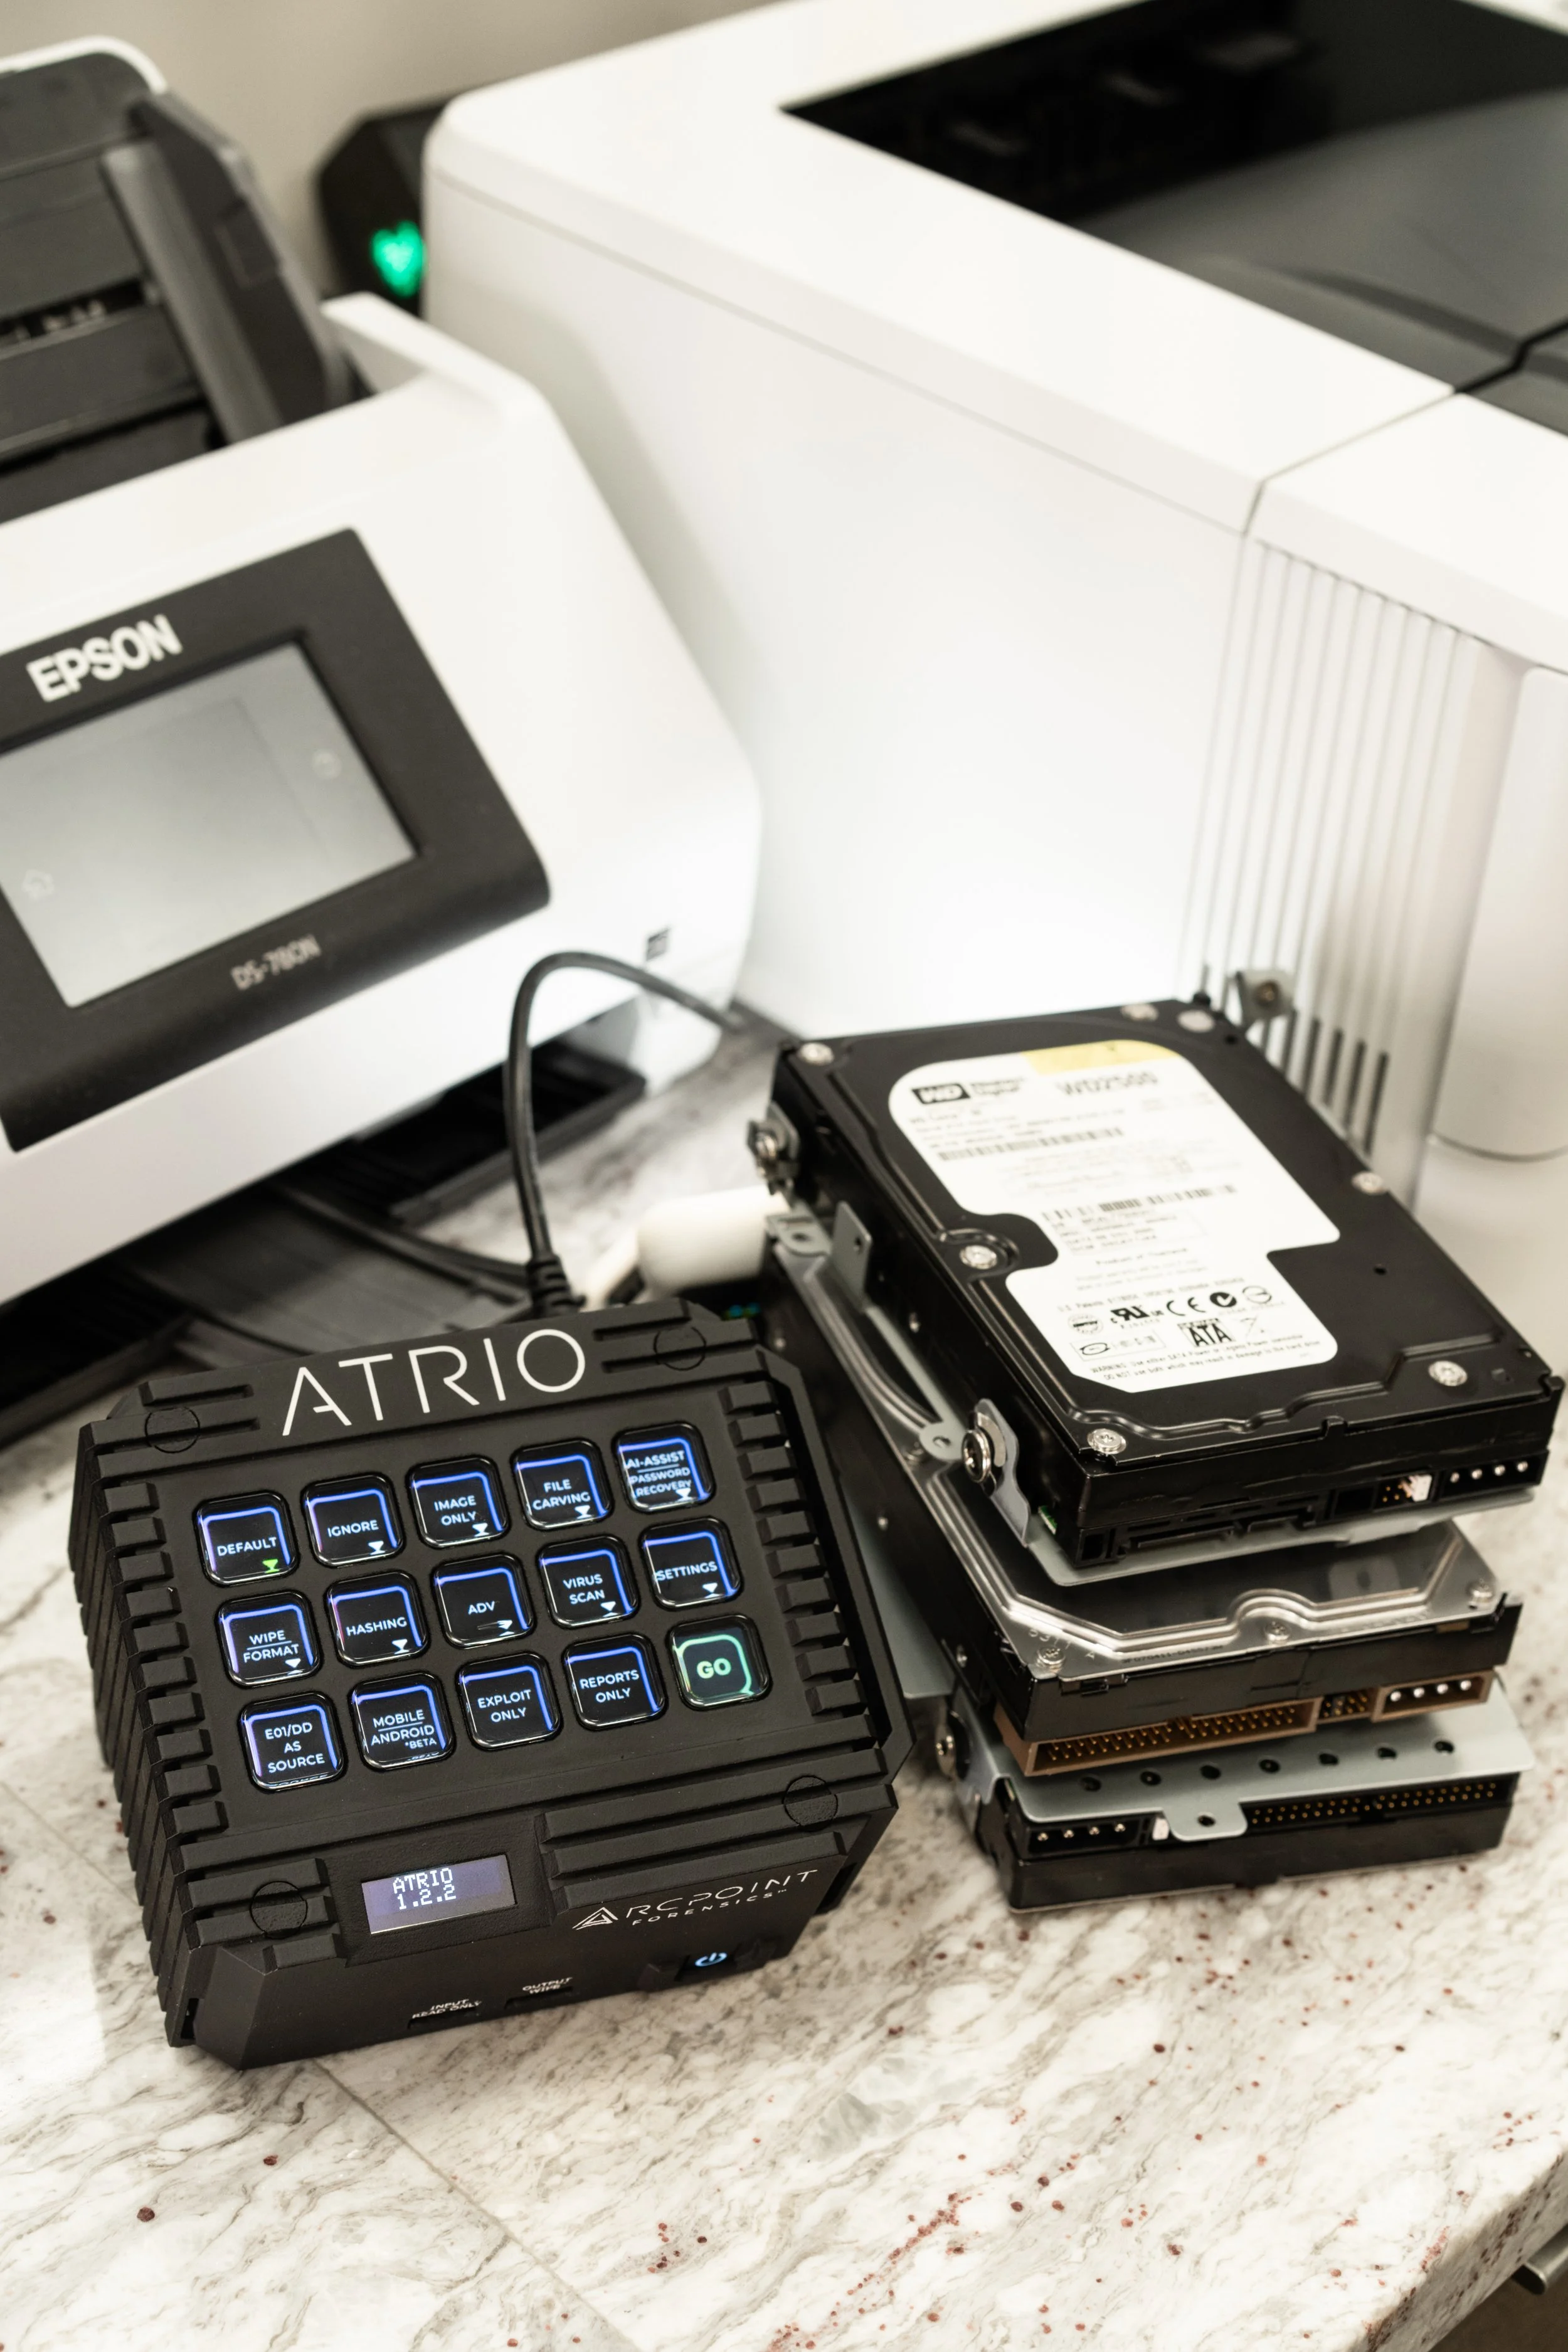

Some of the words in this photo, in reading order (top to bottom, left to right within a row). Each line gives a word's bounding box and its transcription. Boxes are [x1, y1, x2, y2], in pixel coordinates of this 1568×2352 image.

[26, 614, 183, 702] EPSON
[1189, 1323, 1233, 1347] ATA
[282, 1328, 585, 1436] ATRIO
[625, 1450, 685, 1468] AI-ASSIST
[629, 1467, 691, 1485] PASSWORD
[544, 1479, 571, 1493] FILE
[635, 1480, 691, 1497] RECOVERY
[435, 1495, 477, 1512] IMAGE
[532, 1491, 591, 1511] CARVING
[442, 1510, 477, 1526] ONLY
[327, 1518, 379, 1538] IGNORE
[217, 1537, 277, 1557] DEFAULT
[657, 1560, 718, 1582] SETTINGS
[563, 1574, 603, 1590] VIRUS
[569, 1589, 605, 1604] SCAN
[468, 1601, 495, 1616] ADV
[346, 1616, 408, 1637] HASHING
[250, 1629, 286, 1645] WIPE
[243, 1643, 299, 1663] FORMAT
[696, 1658, 732, 1679] GO
[580, 1669, 639, 1690] REPORTS
[478, 1689, 532, 1709] EXPLOIT
[596, 1687, 632, 1703] ONLY
[373, 1709, 425, 1728] MOBILE
[490, 1707, 527, 1723] ONLY
[371, 1725, 435, 1746] ANDROID
[284, 1740, 302, 1754] AS
[268, 1753, 325, 1773] SOURCE
[393, 1867, 453, 1895] ATRIO
[397, 1884, 457, 1911] 1.2.2
[522, 1977, 573, 1991] OUTPUT
[529, 1984, 561, 1994] WIPE
[411, 2008, 446, 2019] READ
[450, 2001, 482, 2011] ONLY
[430, 1998, 470, 2011] INPUT
